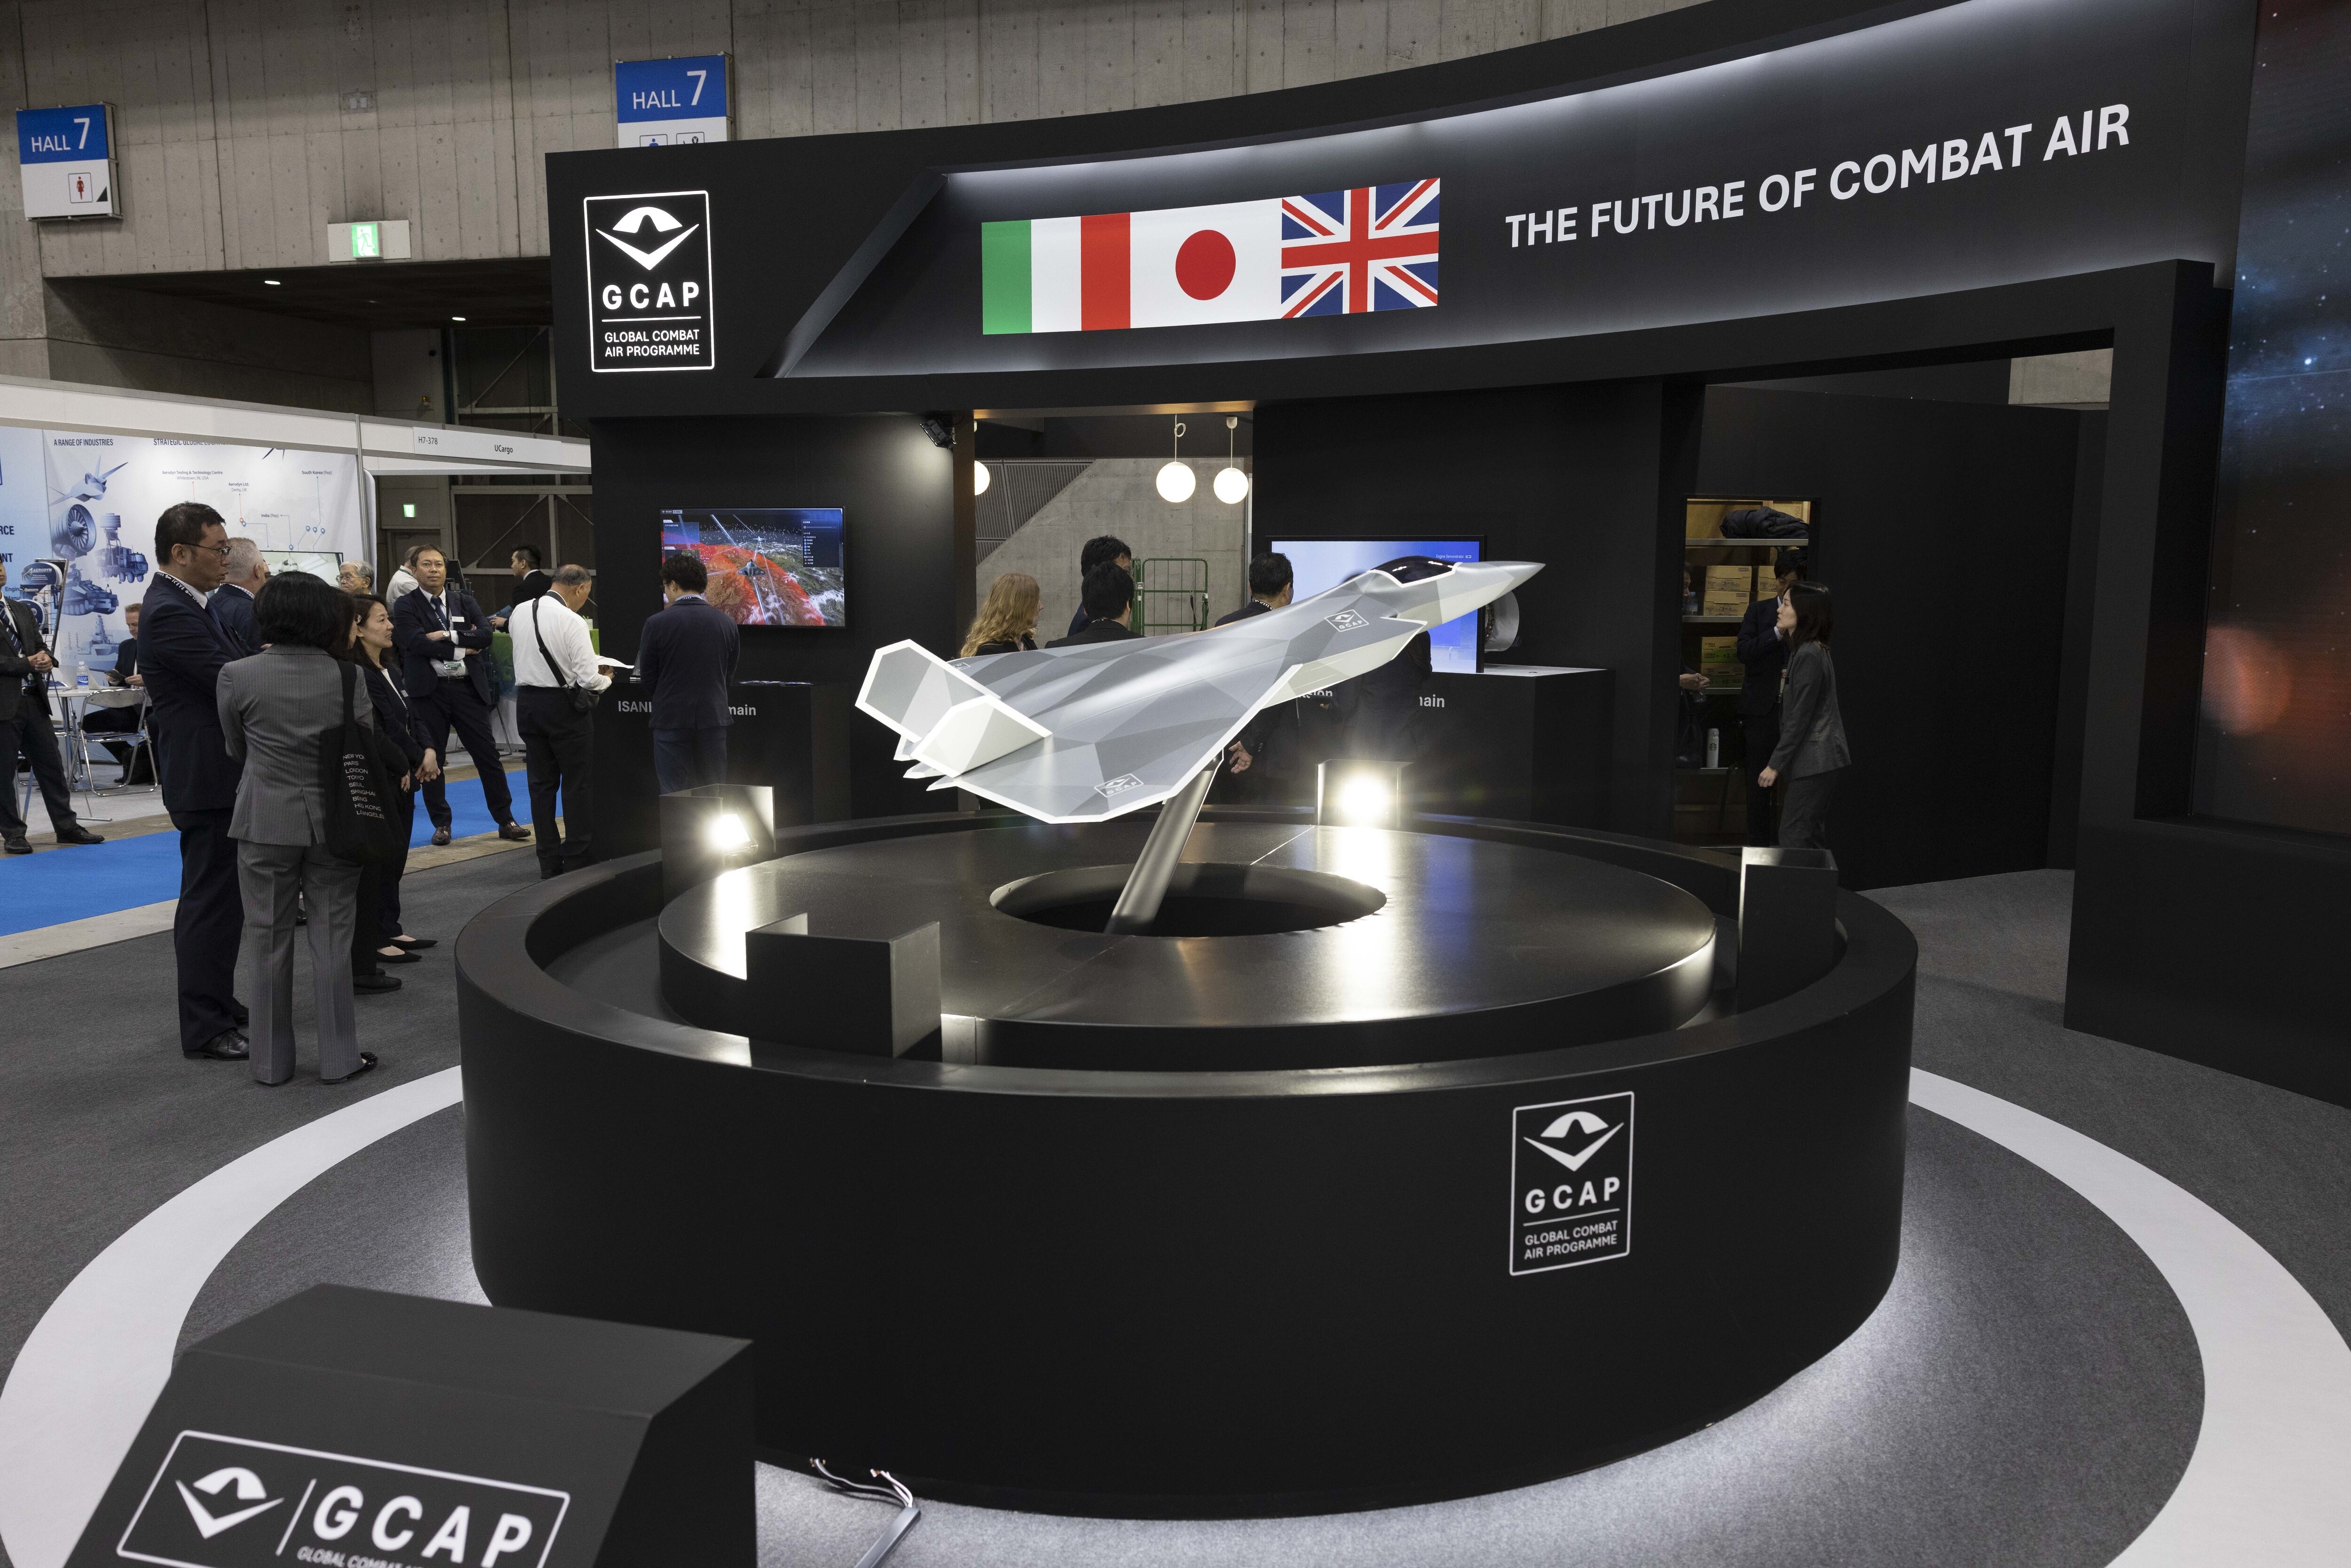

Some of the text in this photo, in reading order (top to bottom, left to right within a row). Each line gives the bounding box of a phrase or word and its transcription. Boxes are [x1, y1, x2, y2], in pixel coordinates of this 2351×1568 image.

[633, 70, 706, 110] HALL 7
[31, 118, 90, 153] HALL 7
[1505, 103, 2130, 248] THE FUTURE OF COMBAT AIR
[602, 282, 699, 310] GCAP
[605, 329, 699, 343] GLOBAL COMBAT
[605, 344, 700, 357] AIR PROGRAMME
[418, 436, 438, 445] H7-378
[494, 444, 513, 455] UCargo
[172, 579, 185, 591] ICEYE
[1339, 620, 1363, 630] GCAP
[1107, 781, 1136, 794] GCAP
[1525, 1177, 1620, 1213] GCAP
[1524, 1220, 1618, 1246] GLOBAL COMBAT
[1524, 1234, 1617, 1260] AIR PROGRAMME
[313, 1485, 533, 1568] GCAP
[297, 1545, 346, 1568] GLOBAL
